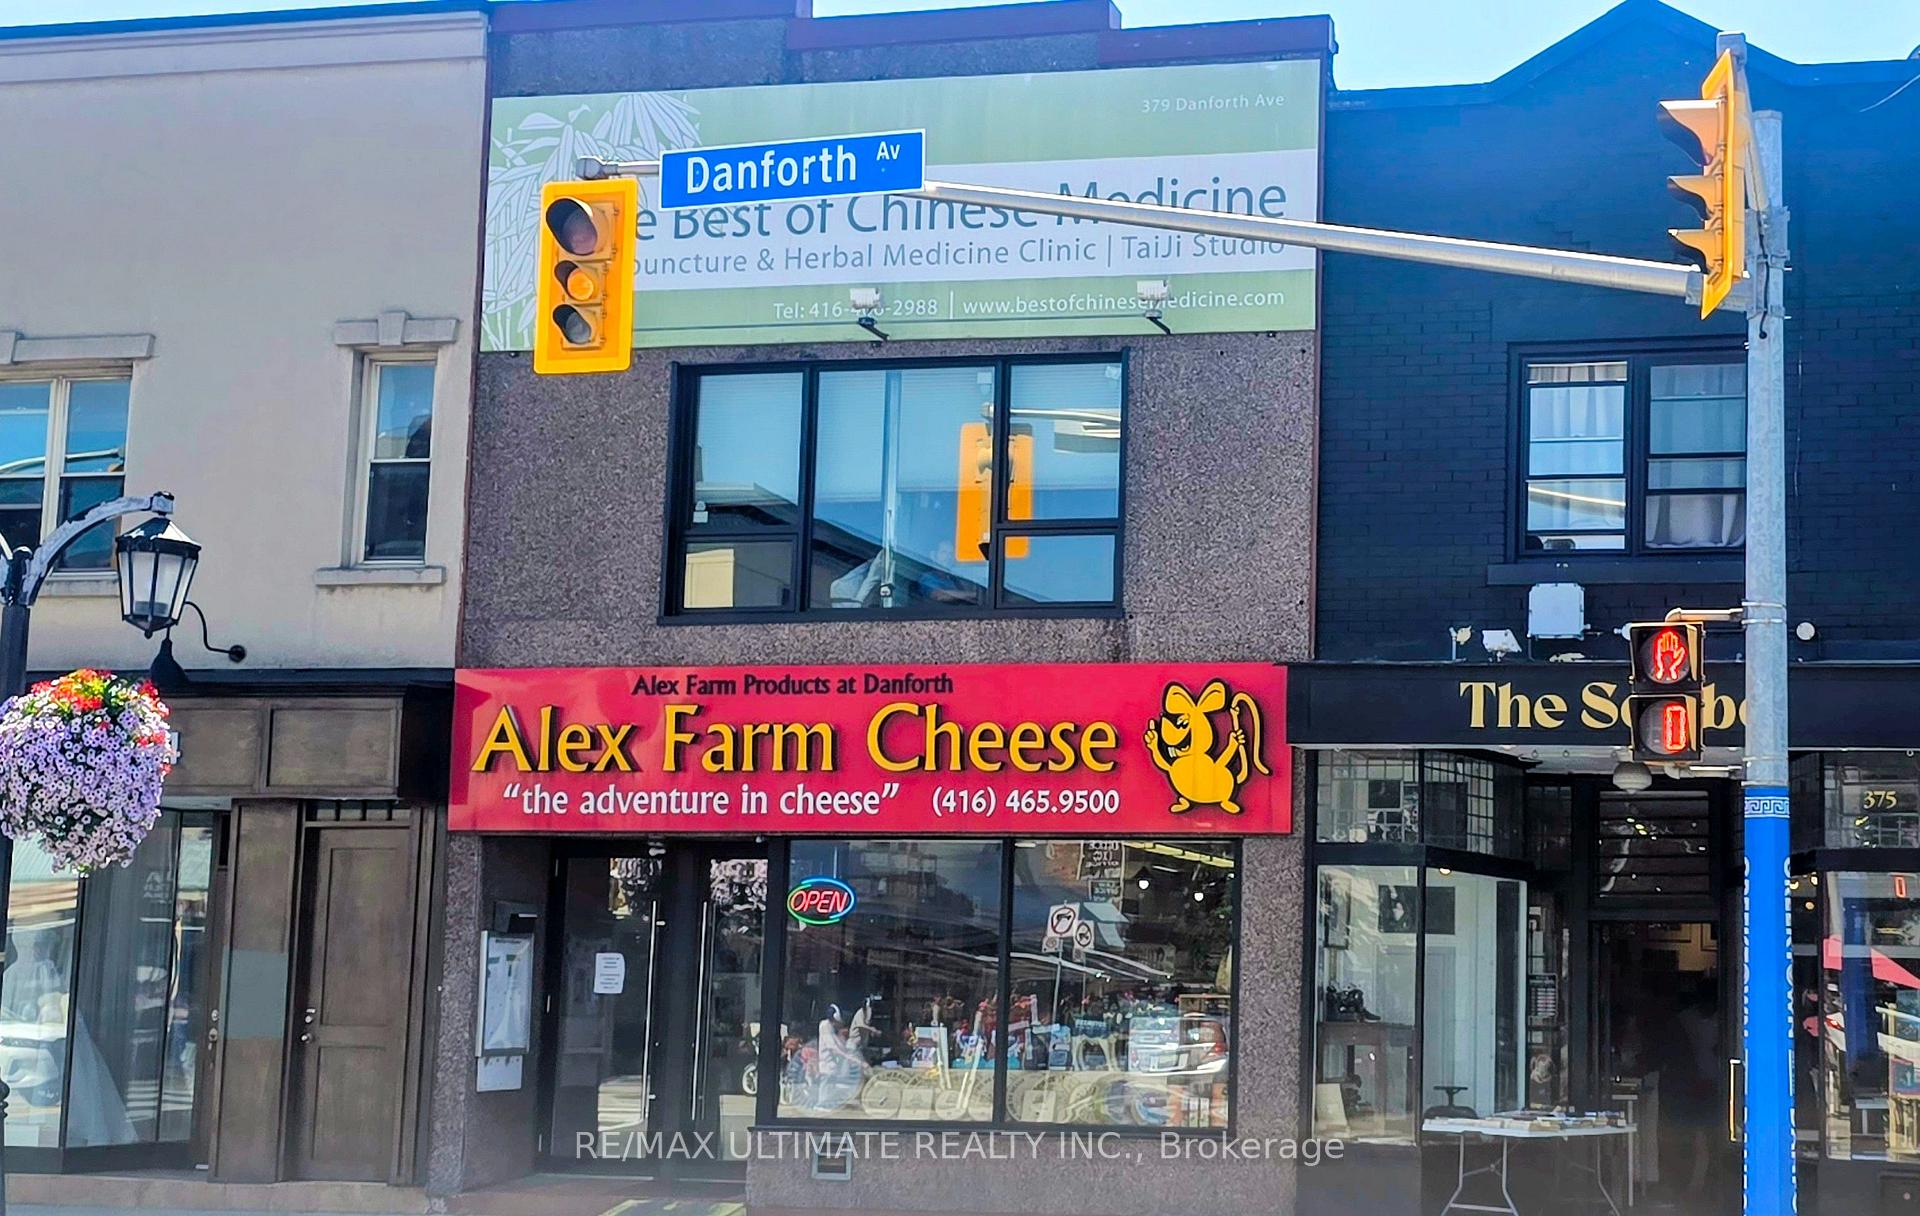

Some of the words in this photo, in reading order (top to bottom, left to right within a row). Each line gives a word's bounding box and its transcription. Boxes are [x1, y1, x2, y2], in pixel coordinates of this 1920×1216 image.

[1142, 98, 1171, 113] 379
[1176, 94, 1249, 112] Danforth
[1255, 93, 1285, 107] Ave
[687, 144, 857, 194] Danforth
[876, 141, 901, 161] Av
[673, 203, 772, 240] Best
[786, 199, 834, 235] of
[756, 248, 775, 272] &
[785, 244, 872, 270] Herbal
[883, 241, 1009, 267] Medicine
[1019, 238, 1097, 263] Clinic
[1121, 234, 1181, 259] TaiJi
[631, 674, 679, 695] Alex
[686, 675, 737, 695] Farm
[744, 674, 831, 695] Products
[836, 676, 857, 694] at
[864, 673, 954, 694] Danforth
[1459, 682, 1568, 729] The
[471, 703, 636, 774] Alex
[662, 703, 837, 773] Farm
[866, 702, 1119, 773] Cheese
[503, 783, 569, 815] “the
[579, 785, 730, 815] adventure
[741, 784, 769, 814] in
[779, 782, 900, 815] cheese”
[932, 786, 997, 817] (416)
[1005, 788, 1120, 815] 465.9500
[1863, 790, 1898, 810] 375
[790, 890, 849, 913] OPEN
